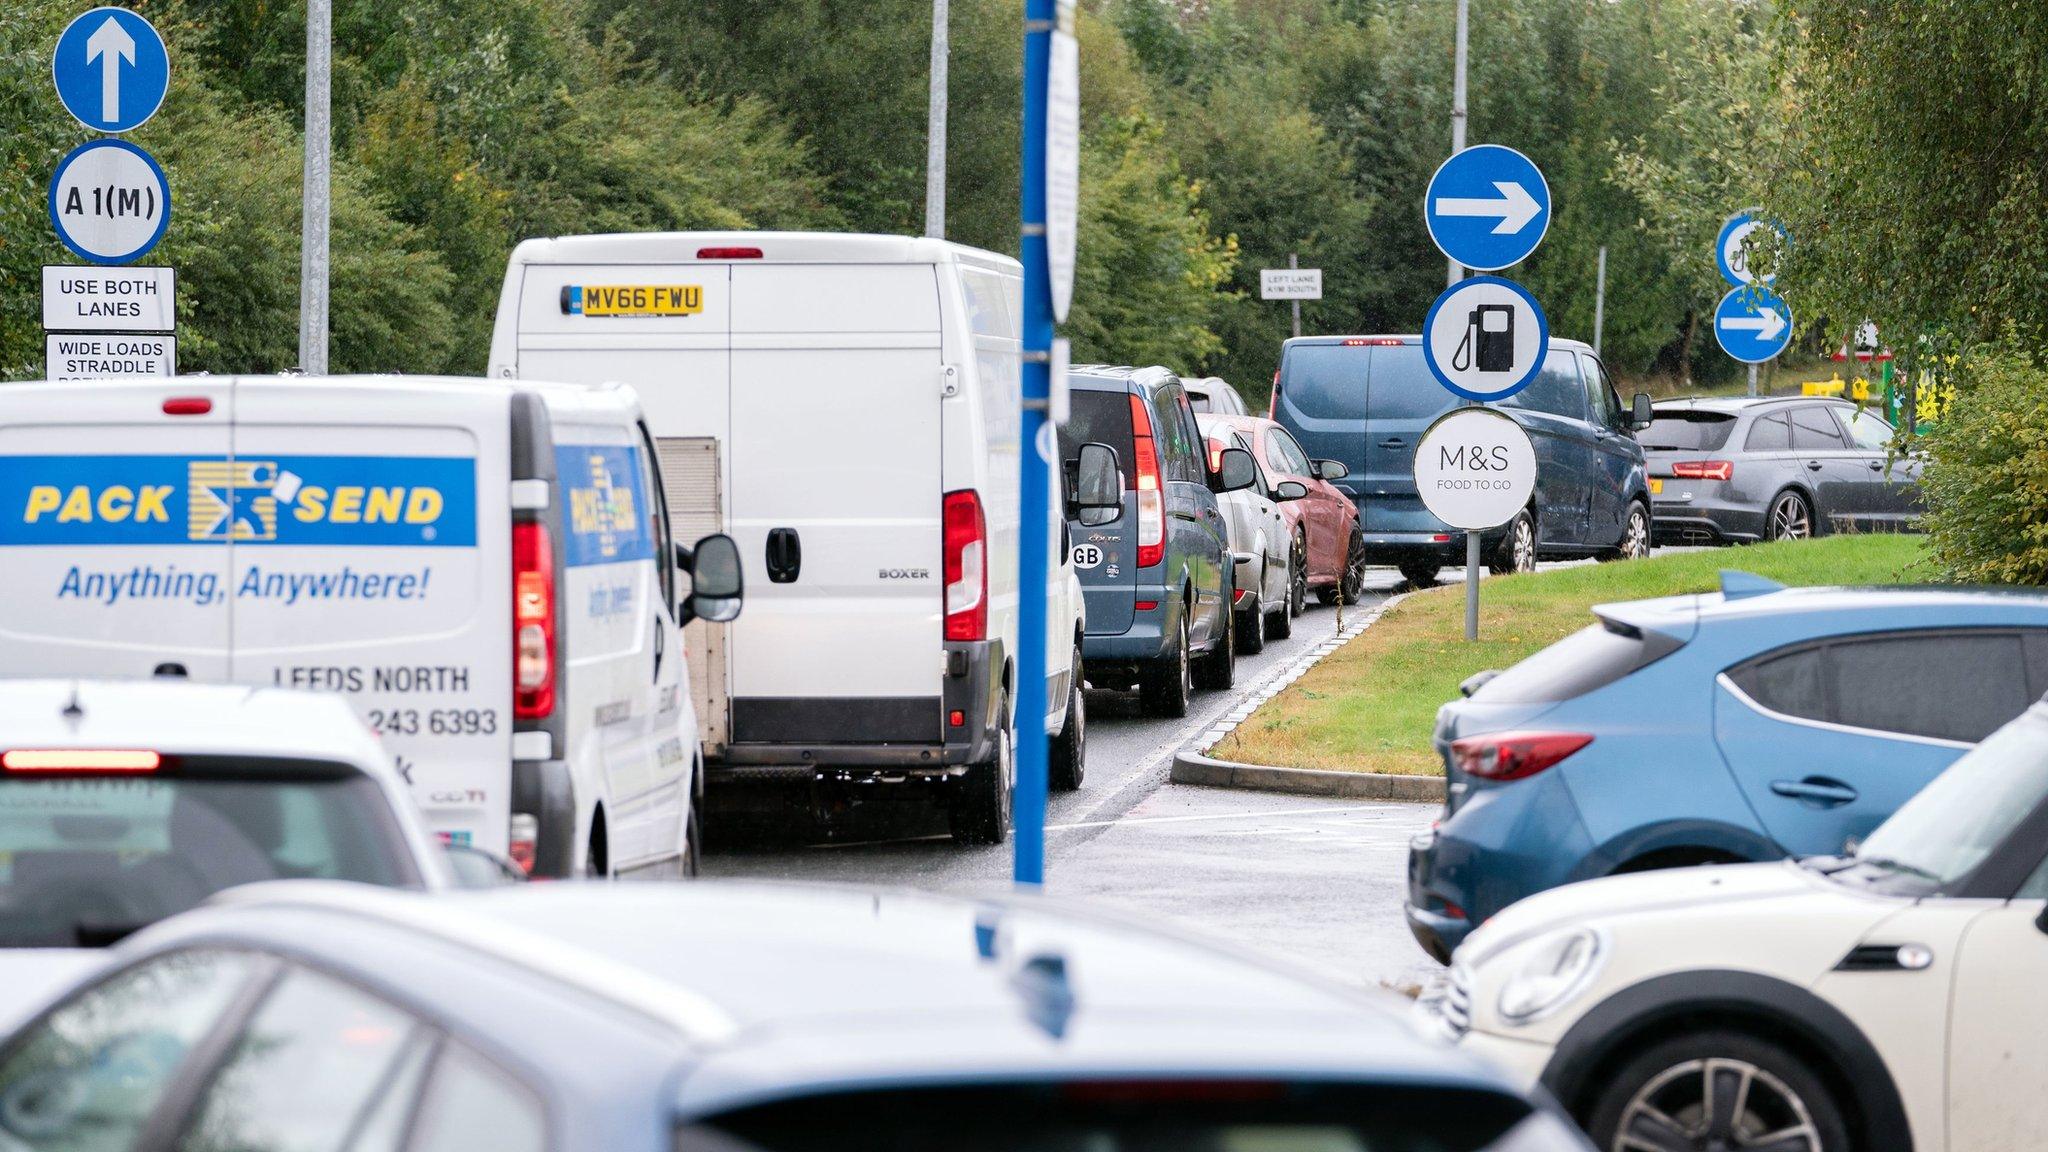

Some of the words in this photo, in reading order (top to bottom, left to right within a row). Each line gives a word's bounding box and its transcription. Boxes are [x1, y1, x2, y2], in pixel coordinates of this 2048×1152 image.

[60, 279, 98, 295] USE
[105, 280, 157, 295] BOTH
[1291, 275, 1315, 283] LANE
[587, 288, 646, 309] MV66
[654, 288, 699, 309] FWU
[78, 302, 141, 317] LANES
[59, 342, 101, 355] WIDE
[107, 343, 163, 356] LOADS
[67, 360, 155, 374] STRADDLE
[1440, 445, 1508, 471] M&S
[1437, 480, 1472, 490] FOOD
[1475, 480, 1490, 490] TO
[1493, 480, 1511, 490] GO
[24, 485, 174, 523] PACK
[292, 486, 444, 524] SEND
[1073, 548, 1099, 564] GB
[879, 568, 929, 579] BOXER
[57, 565, 227, 606] Anything,
[238, 565, 432, 605] Anywhere!
[373, 667, 469, 692] NORTH
[429, 709, 497, 735] 6393
